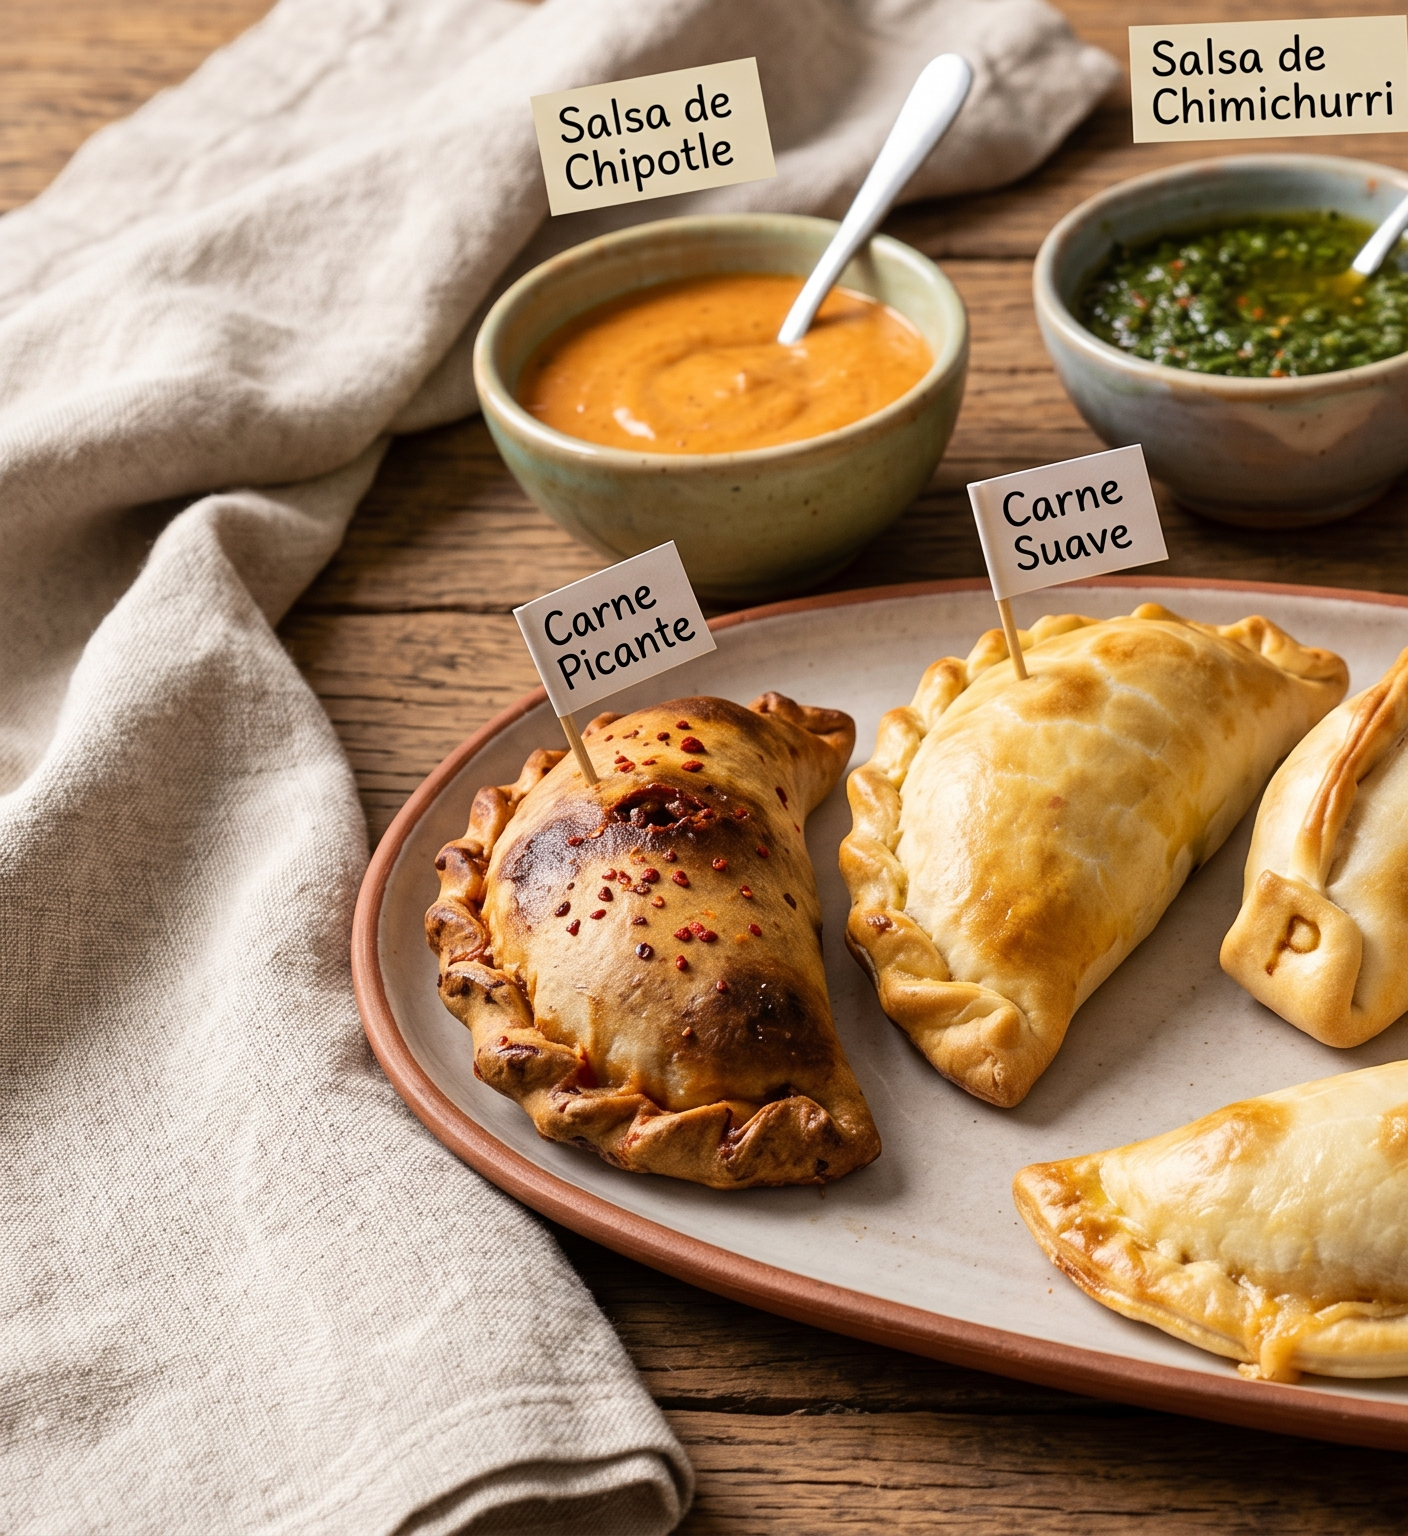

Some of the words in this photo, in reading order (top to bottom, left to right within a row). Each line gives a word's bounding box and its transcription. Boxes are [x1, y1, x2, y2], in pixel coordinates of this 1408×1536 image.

[1152, 37, 1264, 77] Salsa
[1278, 33, 1326, 72] de
[559, 97, 671, 144] Salsa
[684, 83, 732, 123] de
[1152, 80, 1393, 125] Chimichurri
[565, 131, 734, 193] Chipotle
[1002, 480, 1124, 528] Carne
[1014, 524, 1133, 571] Suave
[544, 585, 657, 646] Carne
[556, 616, 696, 691] Picante
[1264, 913, 1321, 977] P
